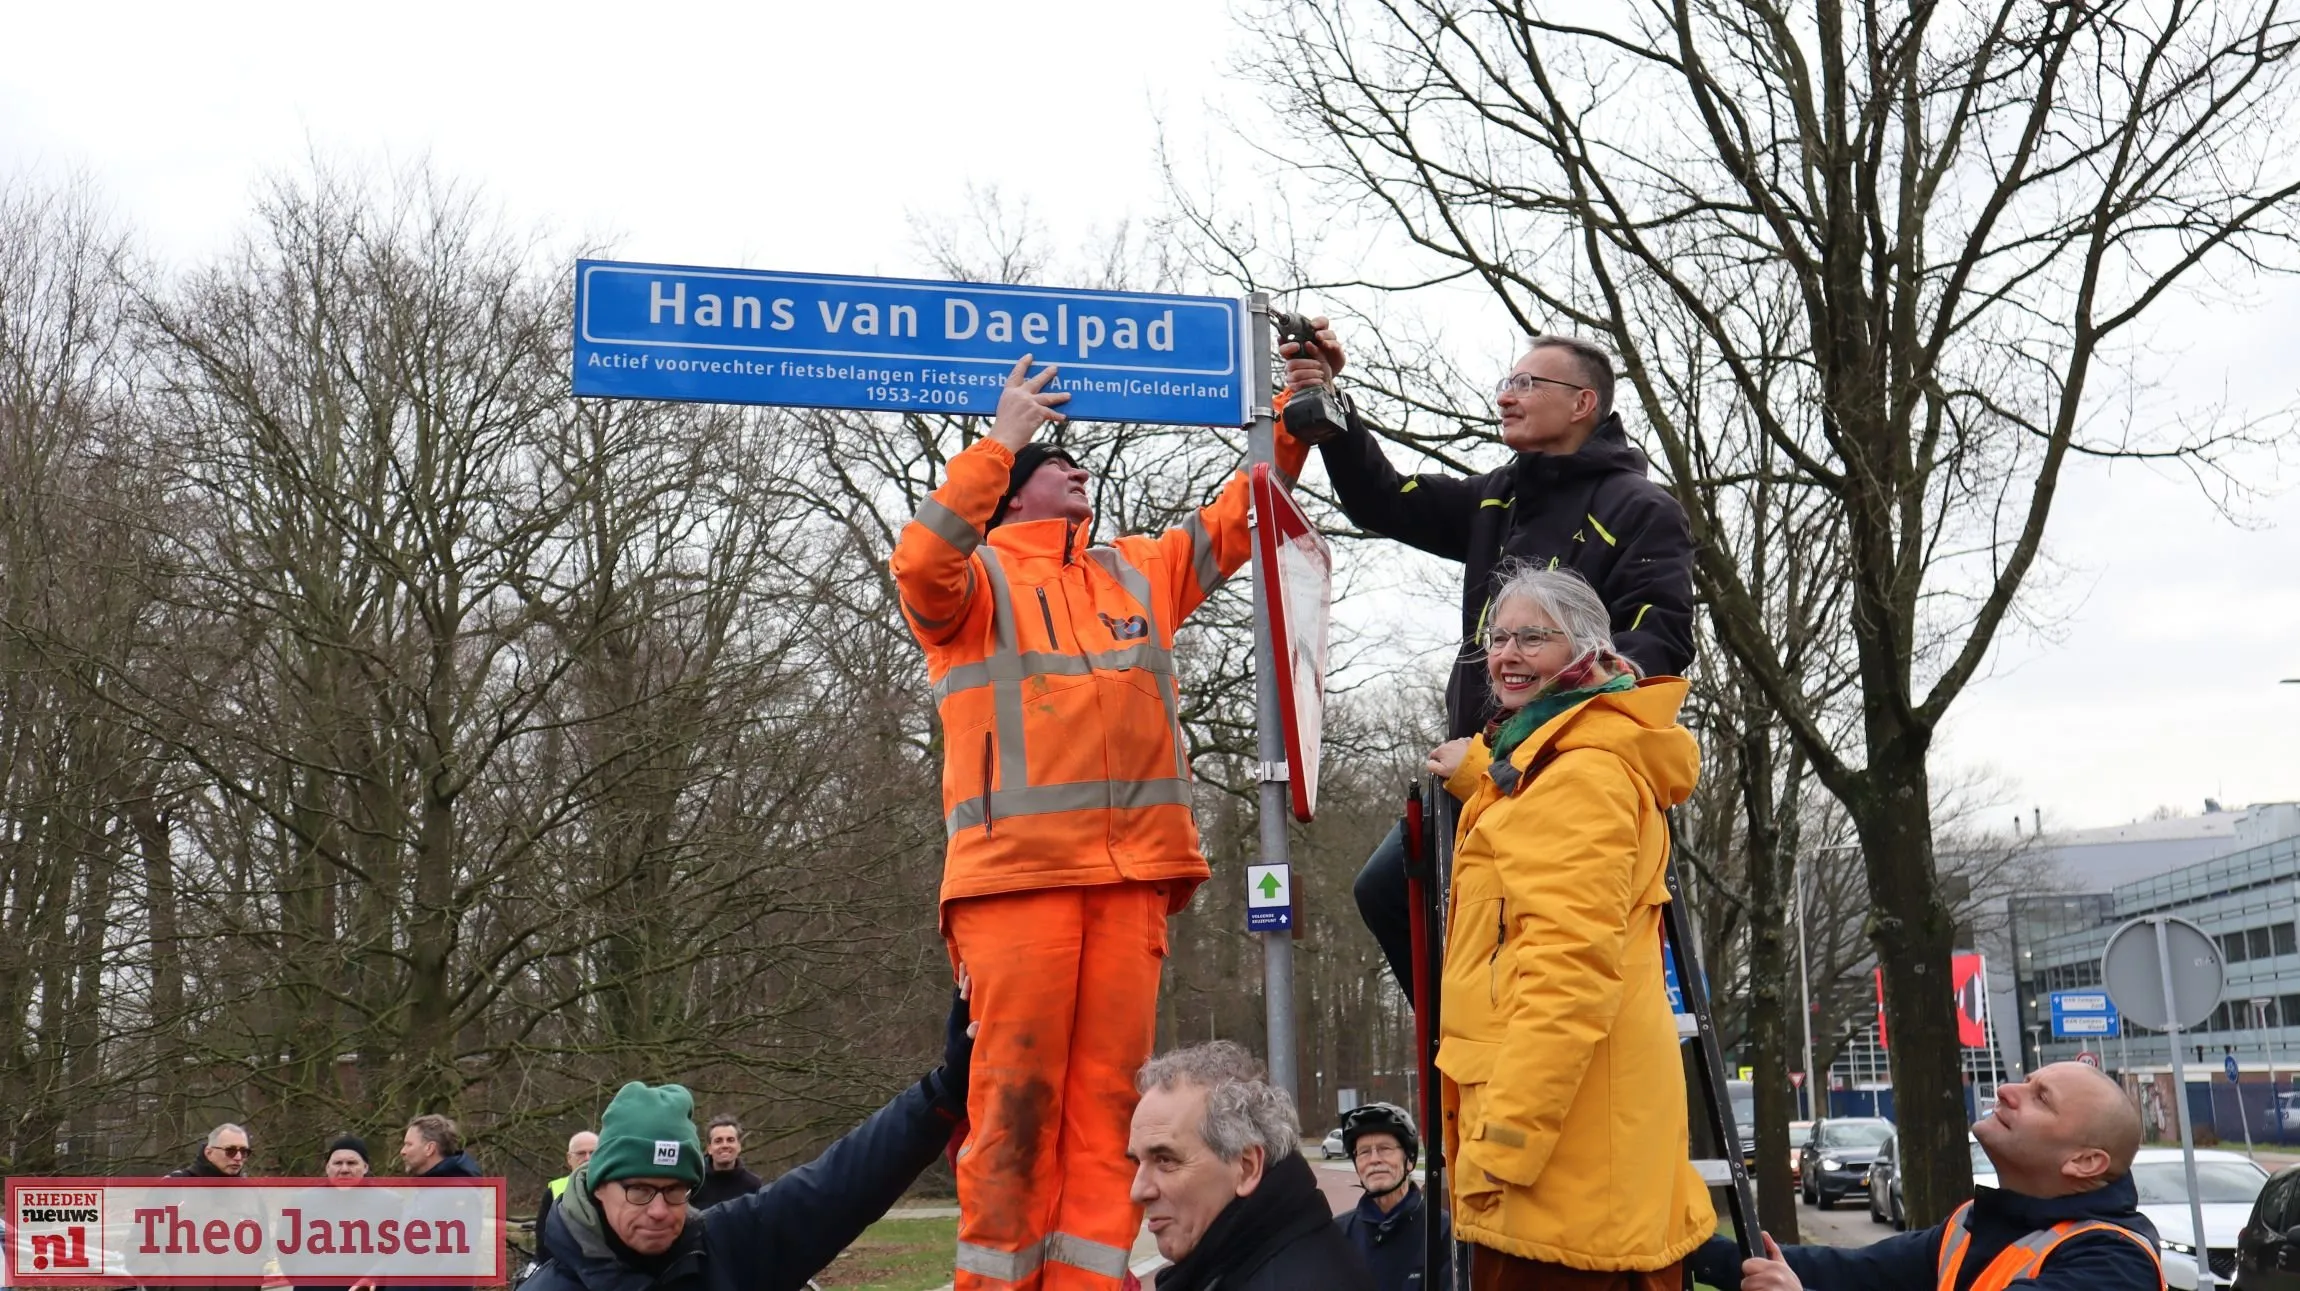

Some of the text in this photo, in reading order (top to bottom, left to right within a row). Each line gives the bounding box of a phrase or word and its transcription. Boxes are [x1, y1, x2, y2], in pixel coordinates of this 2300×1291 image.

[650, 281, 1175, 359] Hans van Daelpad
[588, 352, 1230, 399] Actief voorvechter fietsbelangen Fietsersb Arnhem/Gelderland
[866, 386, 969, 405] 1953-2006
[658, 1147, 676, 1158] NO
